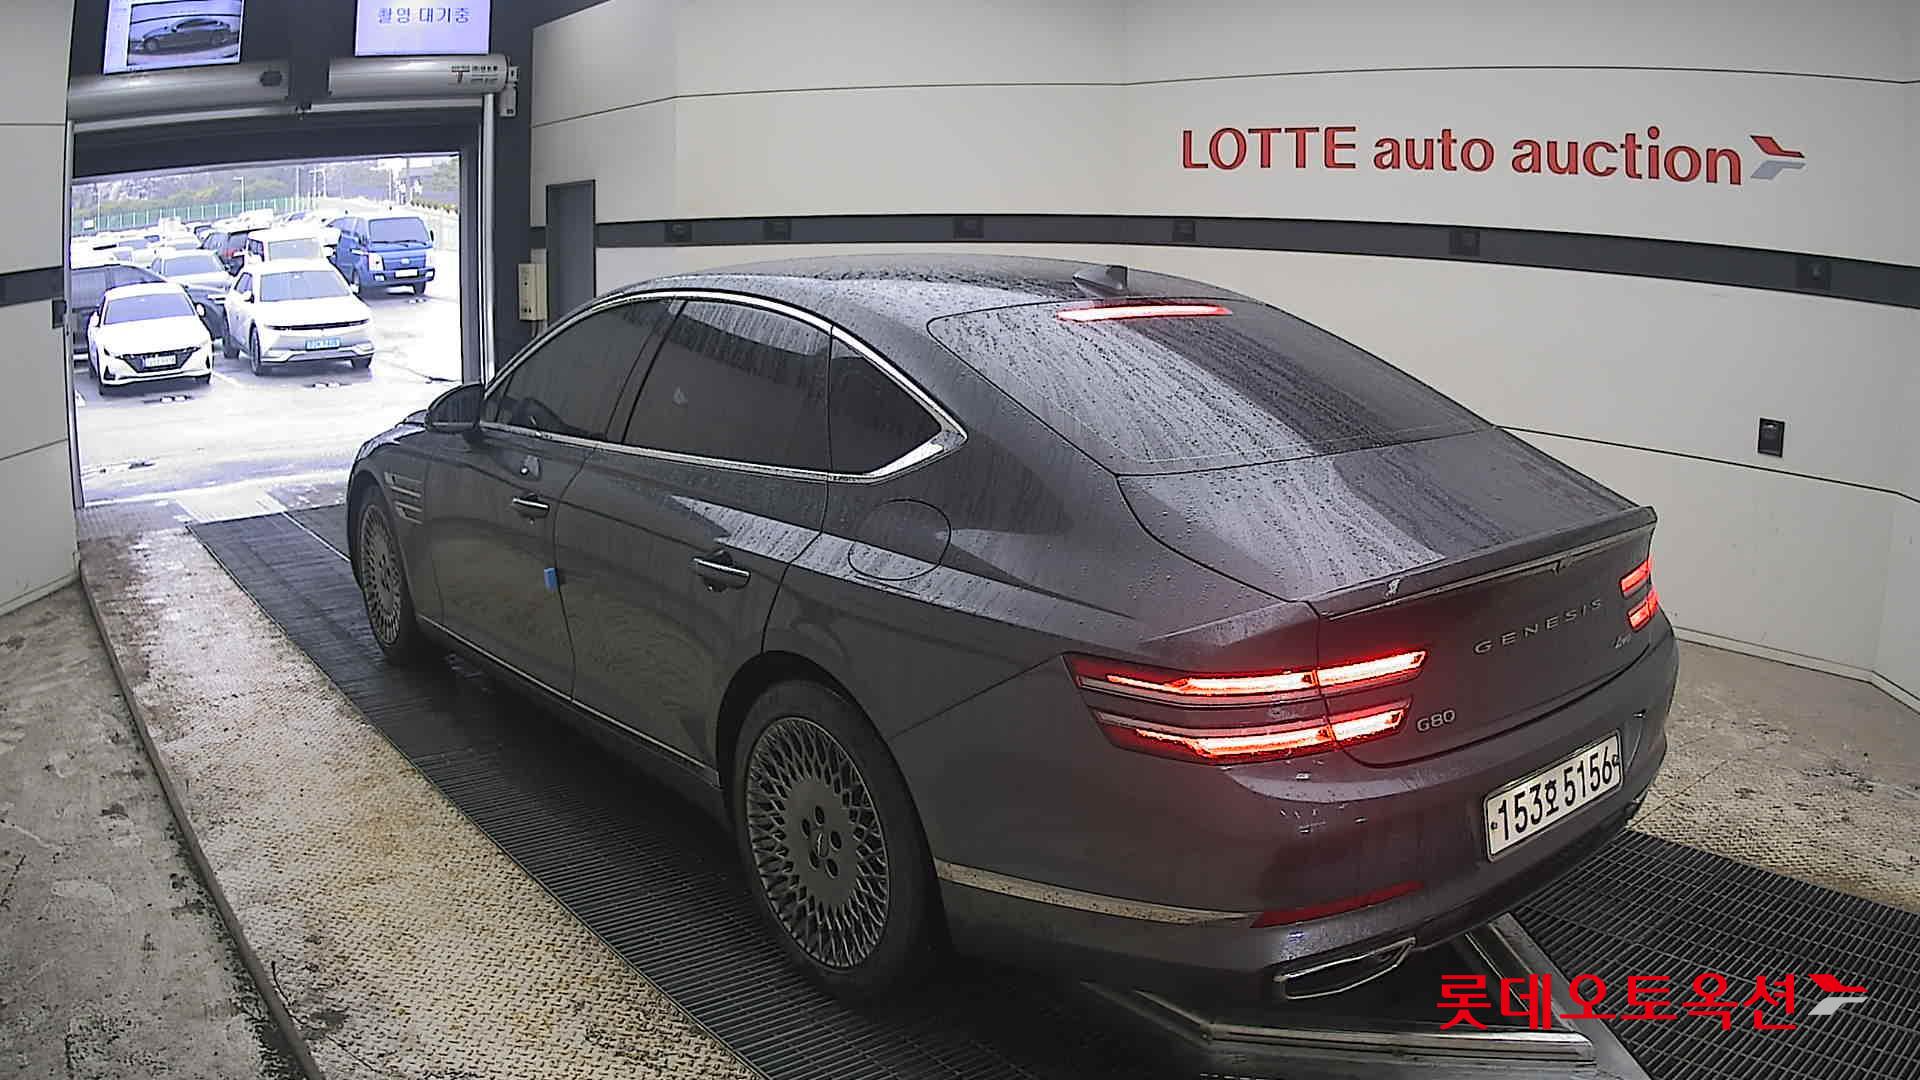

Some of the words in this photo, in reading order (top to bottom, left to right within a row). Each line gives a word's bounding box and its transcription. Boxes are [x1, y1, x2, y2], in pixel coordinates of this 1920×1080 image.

[419, 7, 469, 24] 대기중
[1181, 125, 1357, 170] LOTTE
[1373, 128, 1495, 172] auto
[1510, 125, 1743, 185] auction
[1474, 598, 1603, 654] GENESIS
[1416, 708, 1456, 733] G80
